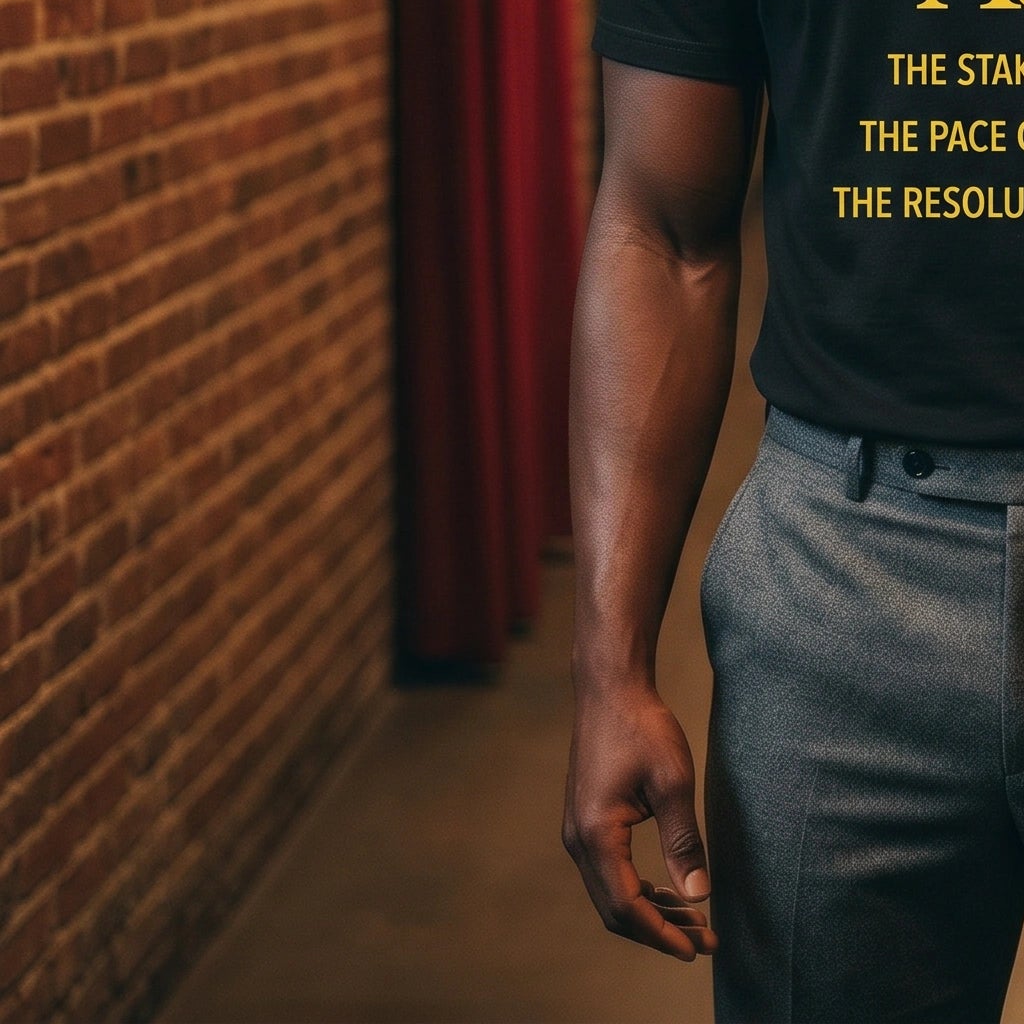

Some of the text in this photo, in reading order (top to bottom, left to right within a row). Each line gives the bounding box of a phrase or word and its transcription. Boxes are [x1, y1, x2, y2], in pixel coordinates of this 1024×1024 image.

[887, 53, 947, 85] THE
[859, 120, 919, 152] THE
[930, 119, 1007, 153] PACE
[832, 186, 892, 218] THE
